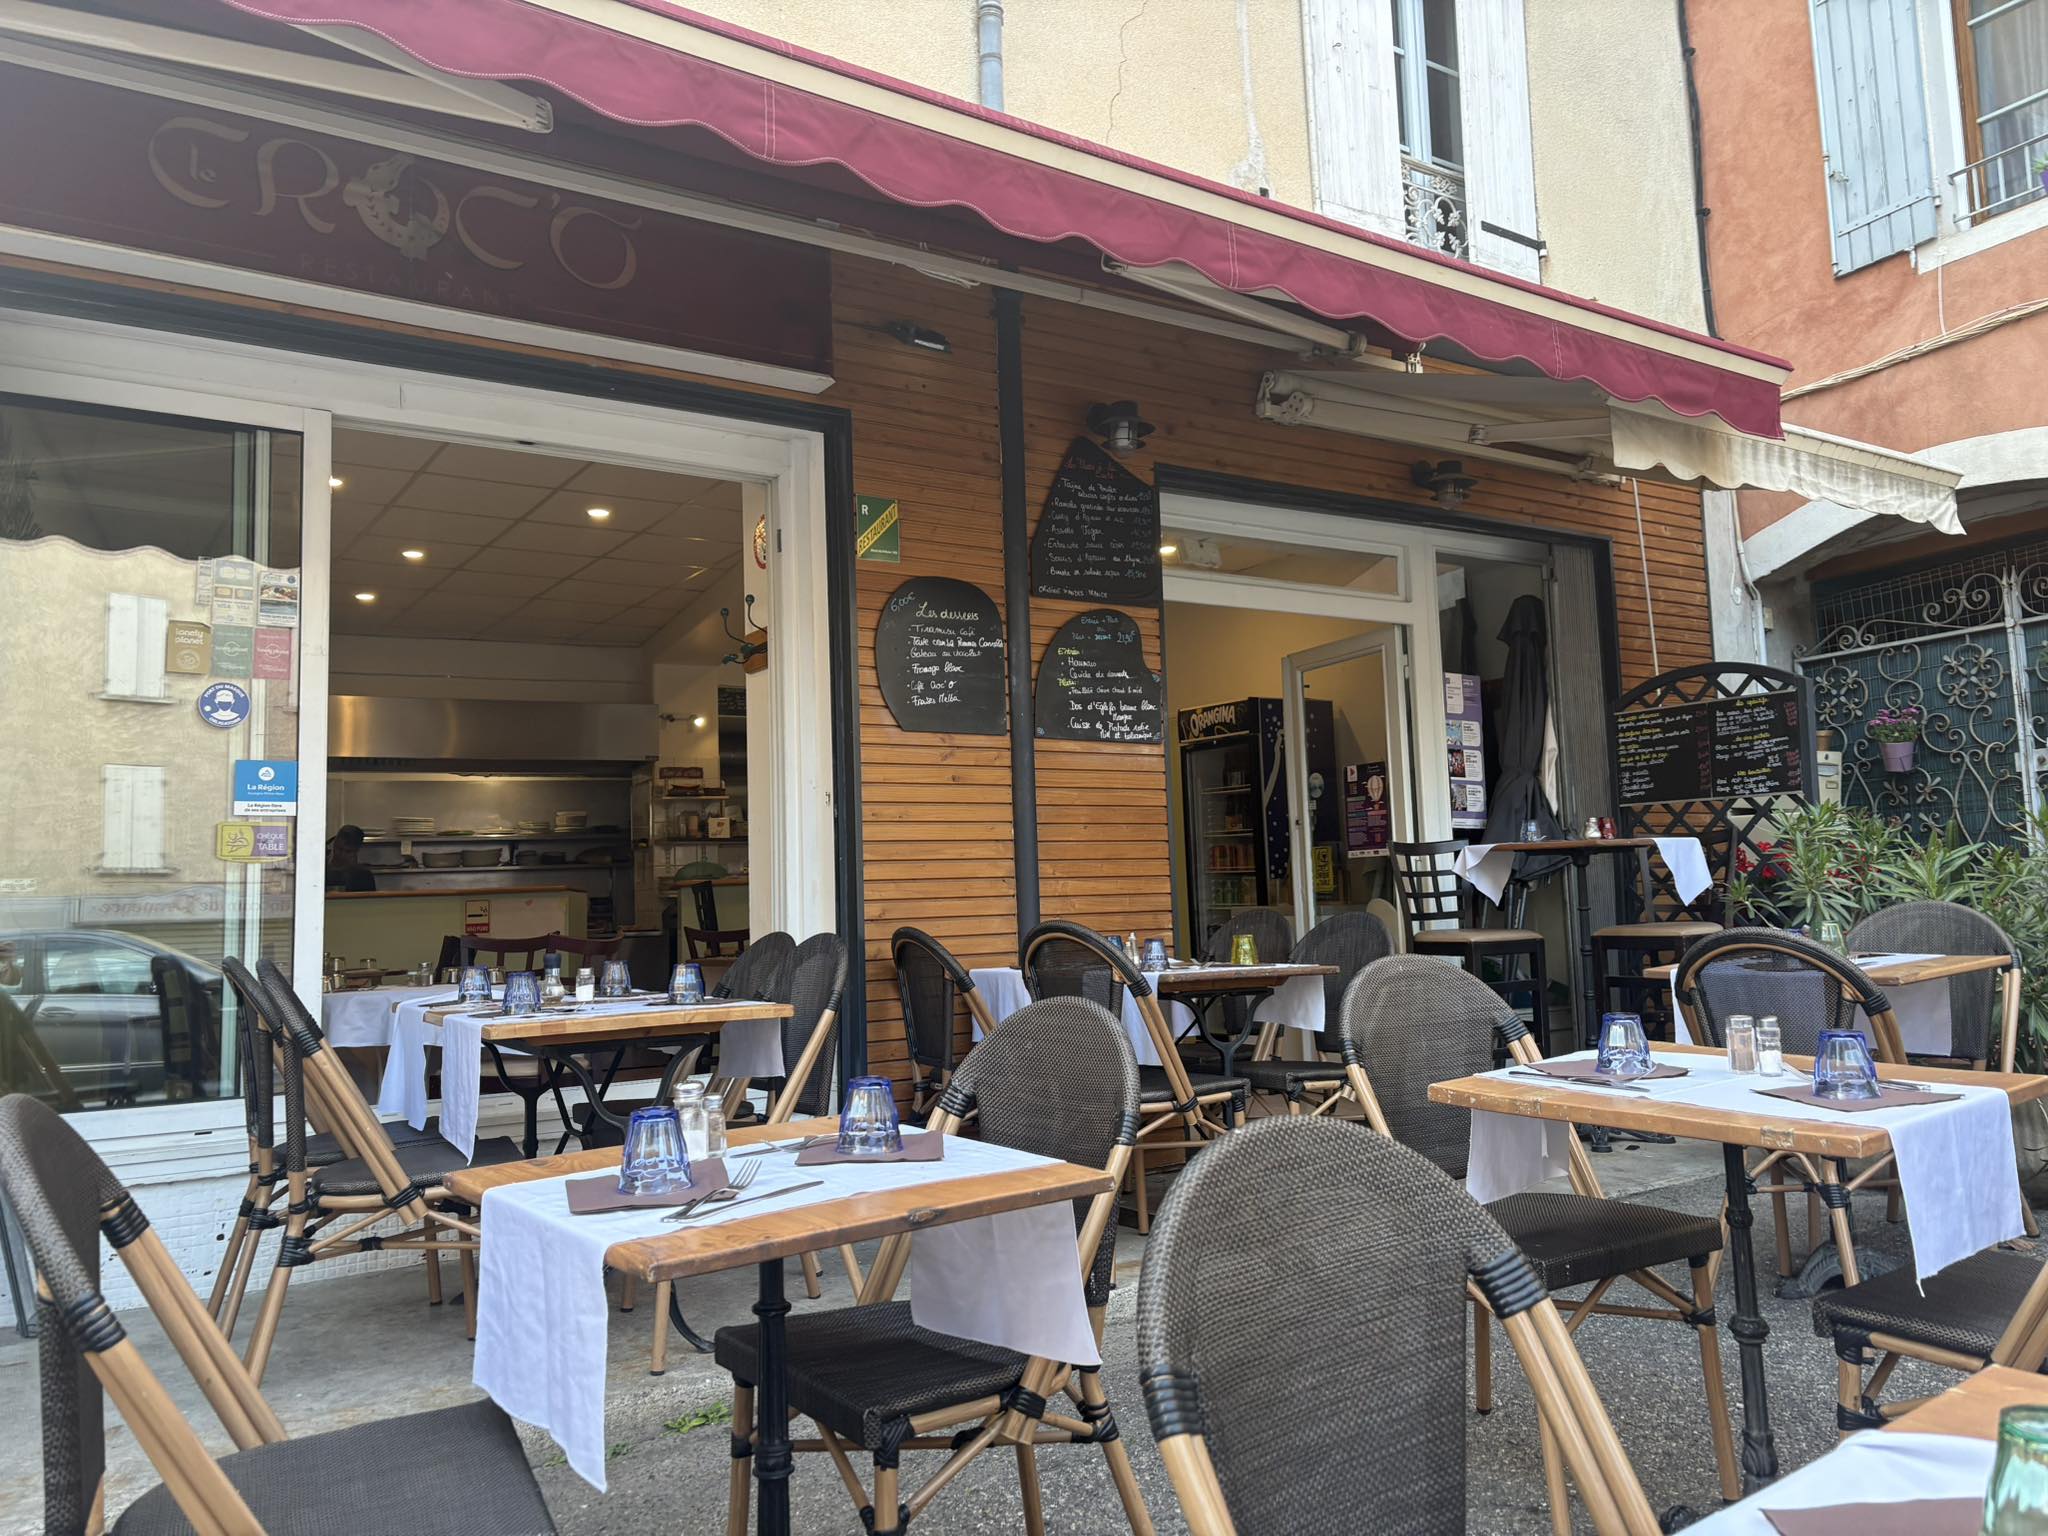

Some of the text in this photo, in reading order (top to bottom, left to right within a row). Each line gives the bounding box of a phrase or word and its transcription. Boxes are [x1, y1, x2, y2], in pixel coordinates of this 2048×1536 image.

[861, 504, 869, 516] R
[858, 504, 897, 555] RESTAURANT
[915, 601, 980, 621] Les desserts
[175, 627, 204, 639] lonely
[910, 623, 956, 636] Tiramisu
[175, 636, 204, 646] planet
[1190, 704, 1236, 738] ORANGINA
[257, 783, 285, 792] Région
[256, 843, 285, 851] TABLE
